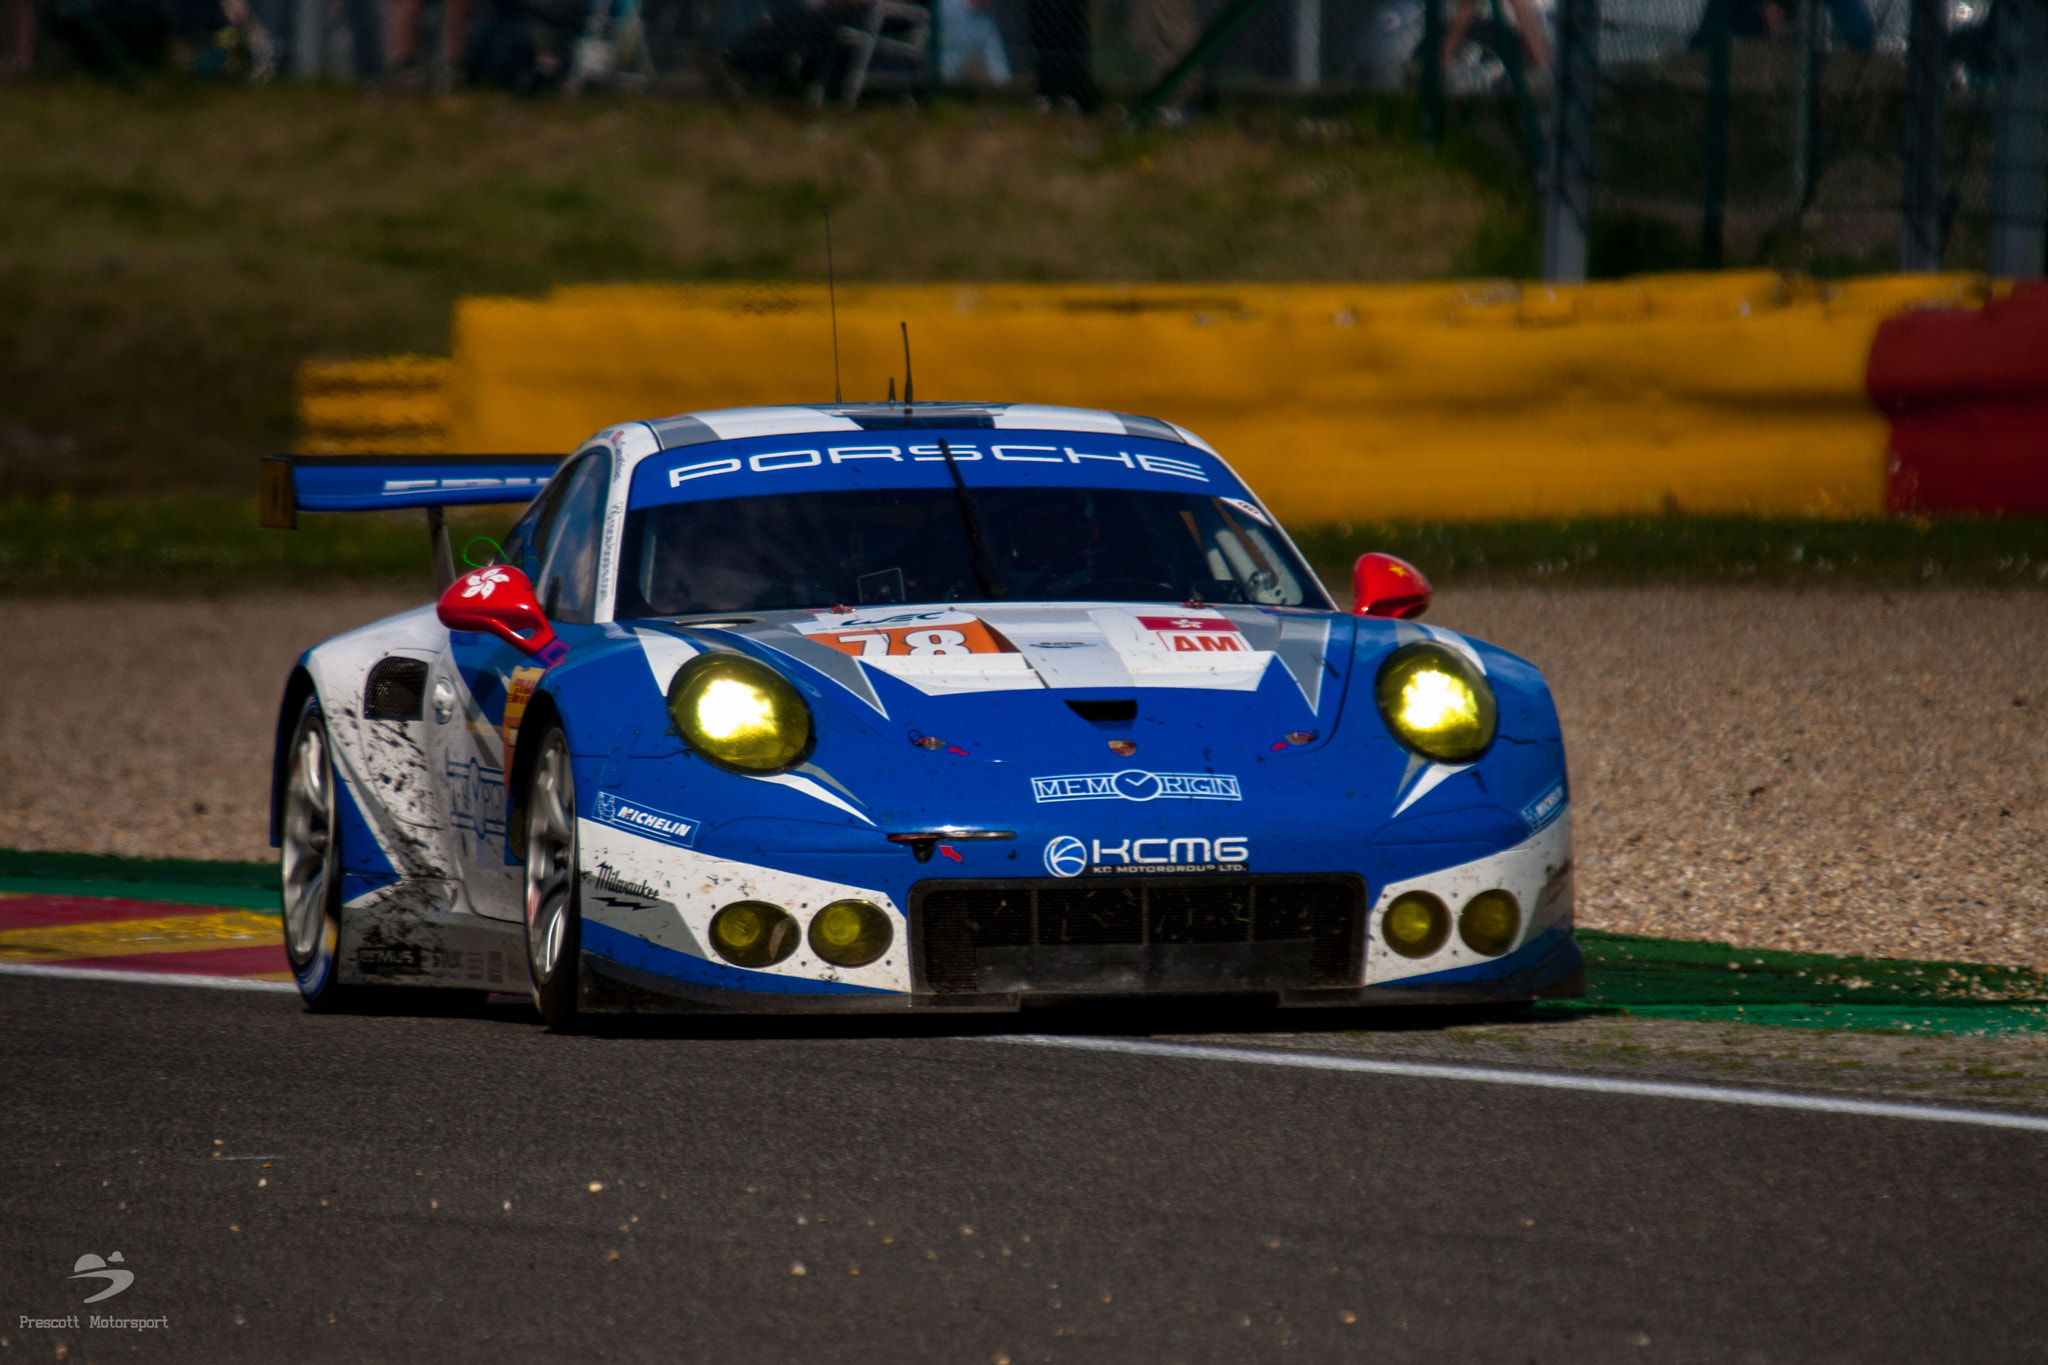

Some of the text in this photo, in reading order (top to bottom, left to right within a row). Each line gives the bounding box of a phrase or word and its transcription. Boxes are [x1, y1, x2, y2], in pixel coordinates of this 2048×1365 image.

[669, 444, 1210, 488] PORSCHE
[841, 611, 945, 626] WEC
[836, 628, 972, 656] 78
[1172, 635, 1242, 652] AM
[617, 806, 692, 837] MICHELIN
[1092, 837, 1249, 864] KCMG
[596, 860, 660, 901] Milwaukee
[1093, 863, 1248, 875] KC MOTORGROUP LTD.
